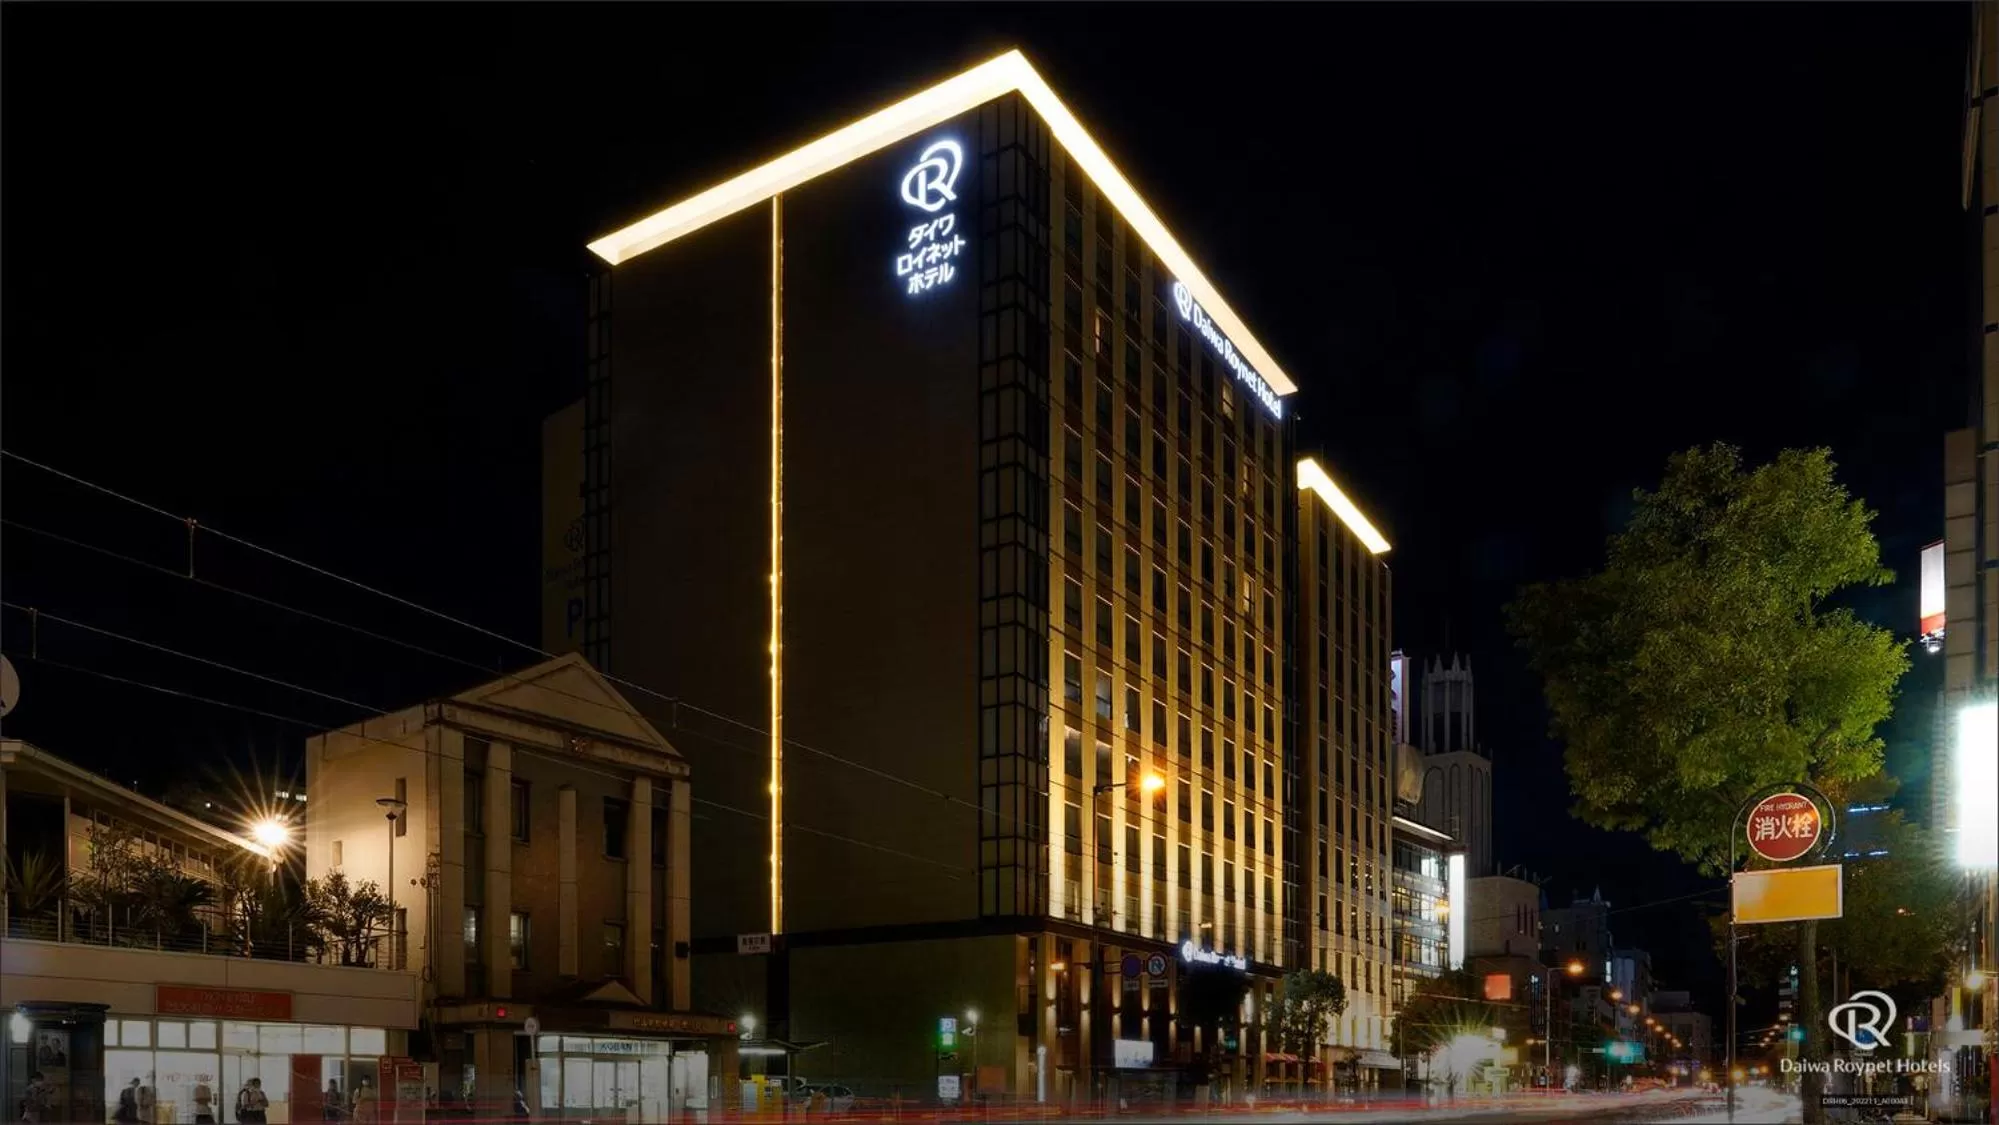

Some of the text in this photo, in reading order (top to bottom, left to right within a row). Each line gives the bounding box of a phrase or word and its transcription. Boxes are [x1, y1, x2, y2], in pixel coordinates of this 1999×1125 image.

[908, 213, 955, 248] ダイワ
[896, 236, 966, 276] ロイネット
[908, 263, 955, 295] ホテル
[1193, 303, 1224, 355] Daiwa
[1224, 339, 1257, 393] Roynet
[1257, 377, 1282, 419] Hotel
[1754, 813, 1814, 842] 消火栓
